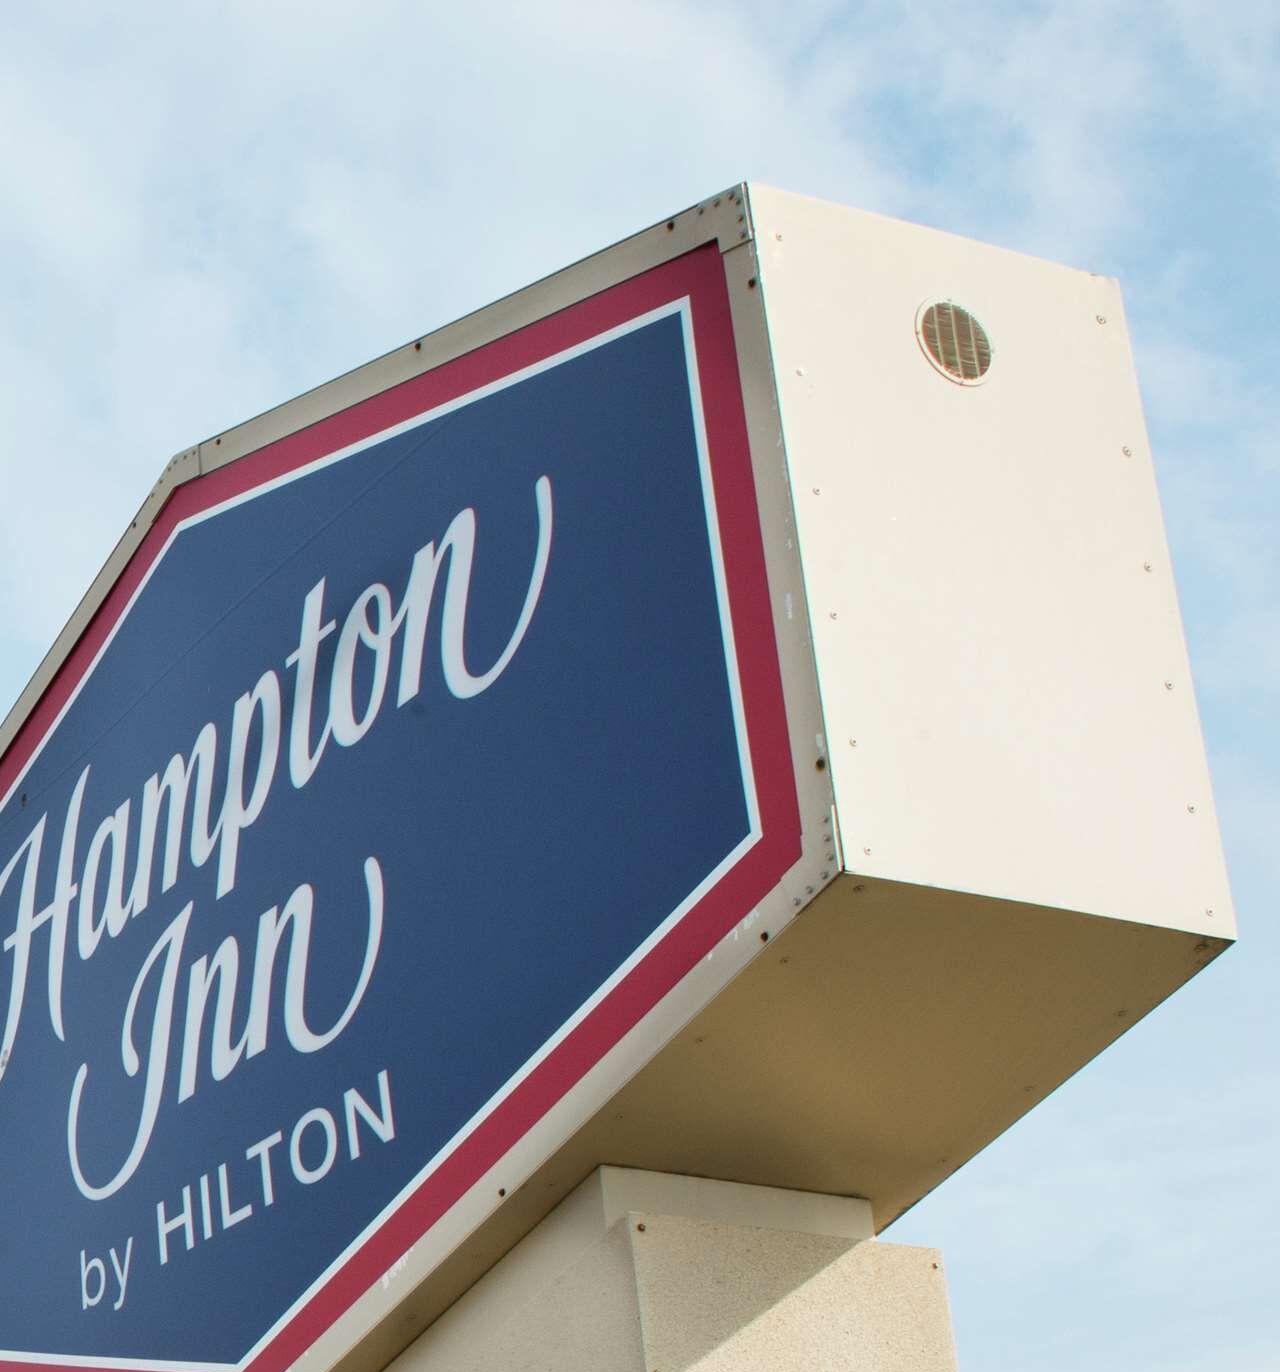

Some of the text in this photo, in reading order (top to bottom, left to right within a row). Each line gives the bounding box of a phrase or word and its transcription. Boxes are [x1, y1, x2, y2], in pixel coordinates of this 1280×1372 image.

[66, 855, 385, 1202] Inn
[78, 1068, 396, 1312] by HILTON
